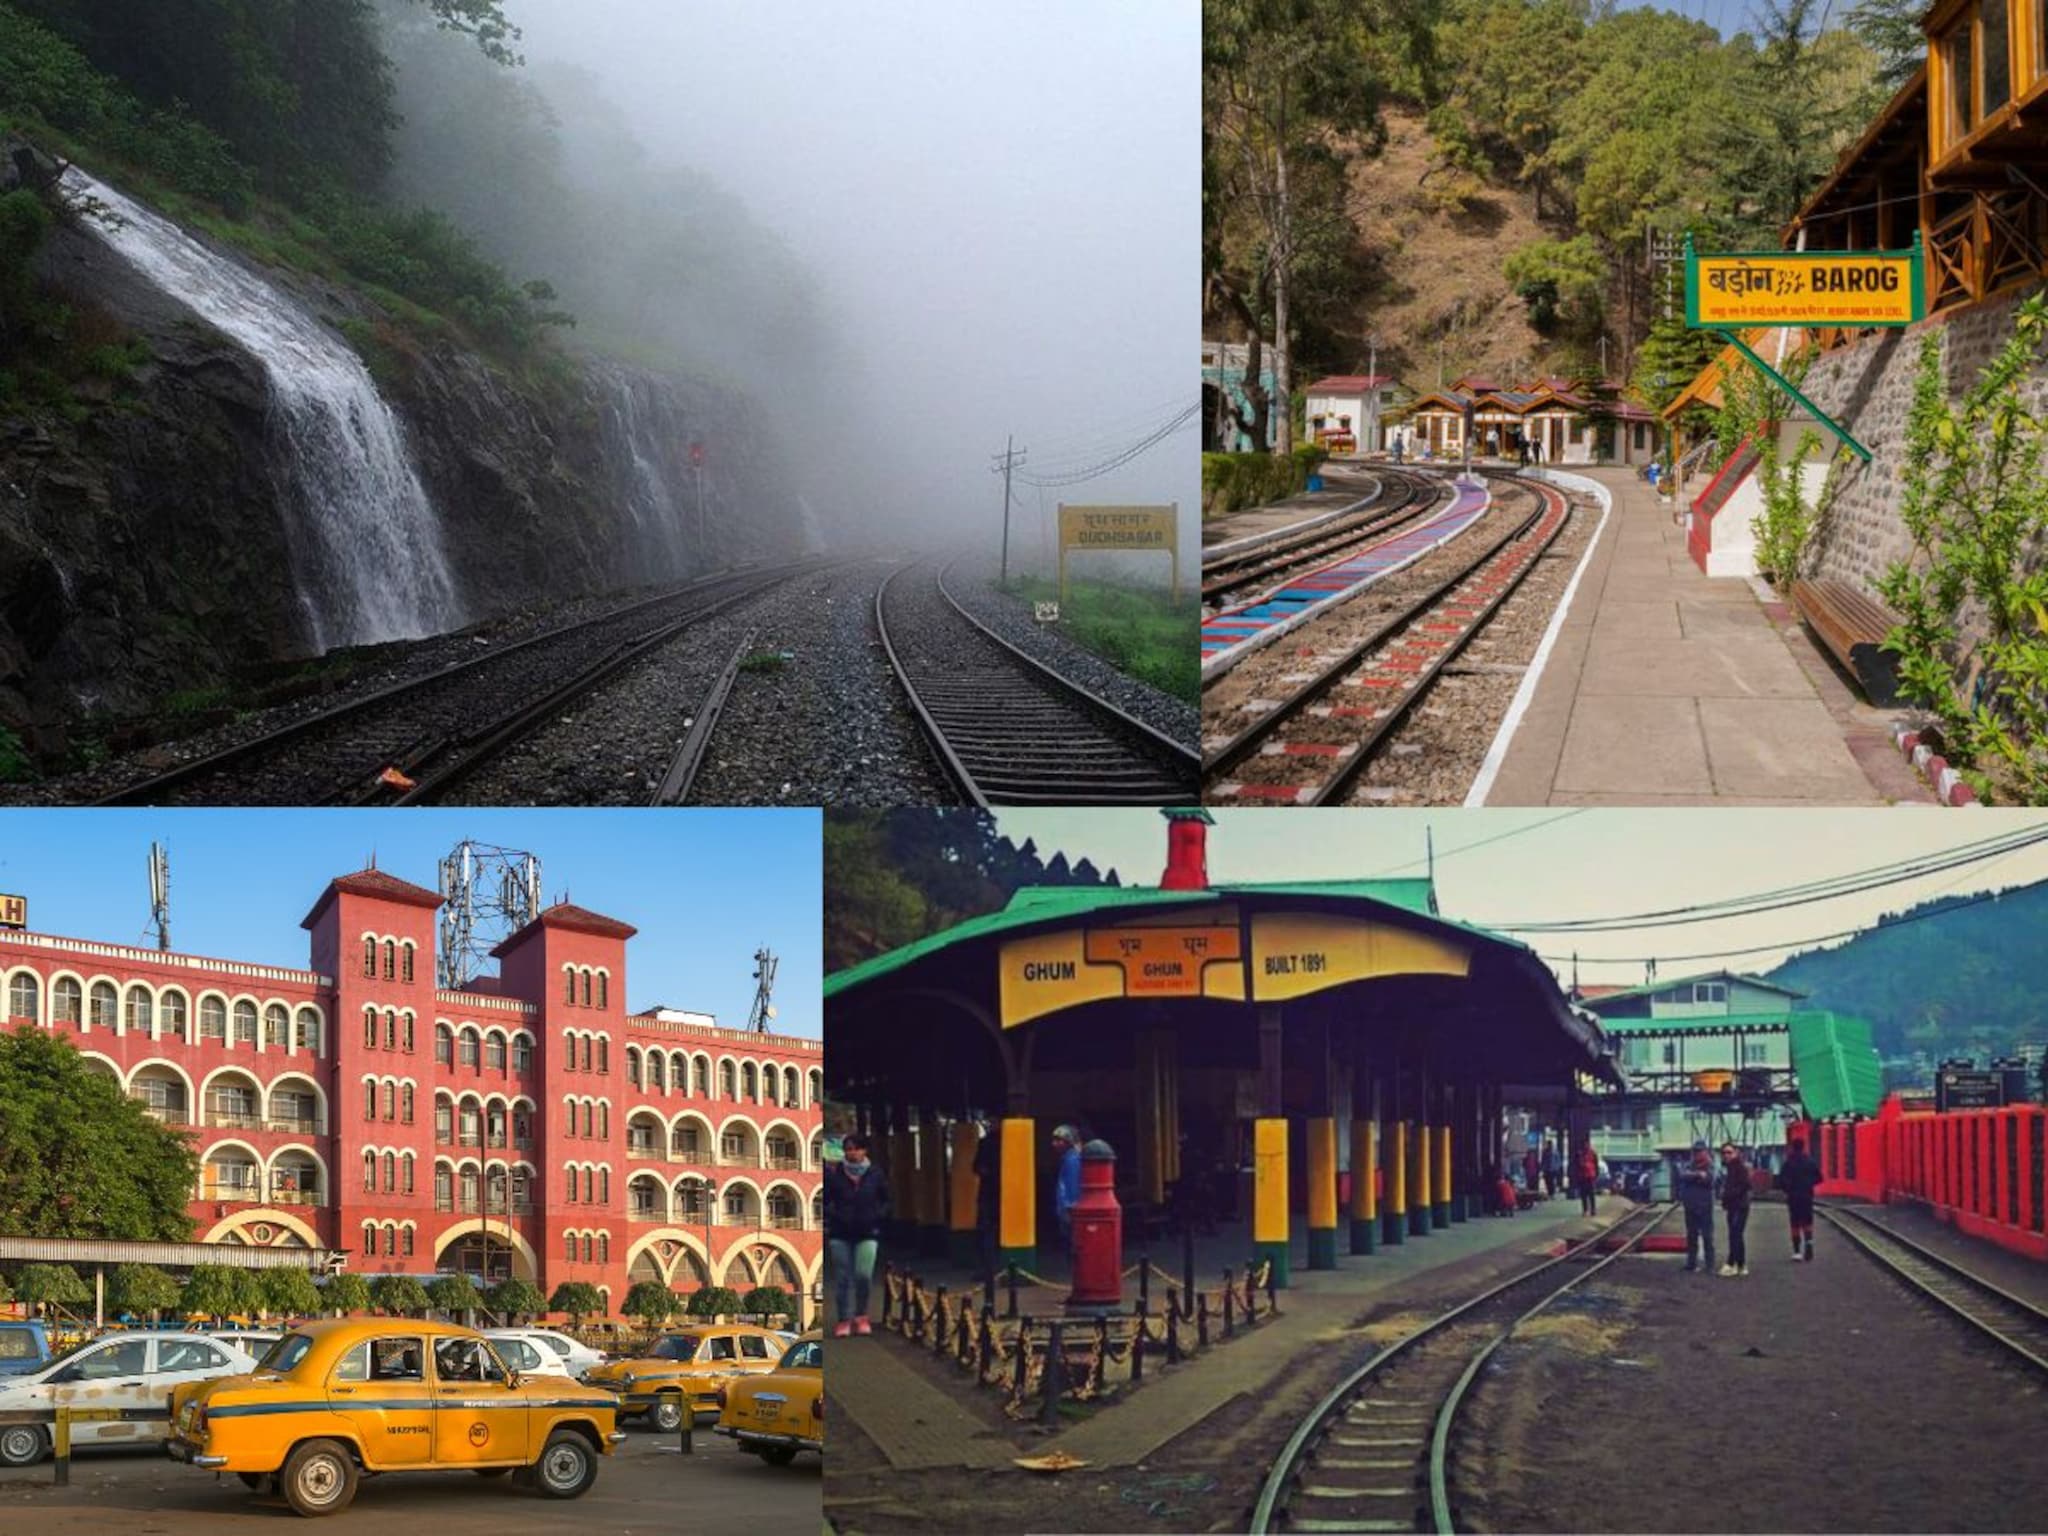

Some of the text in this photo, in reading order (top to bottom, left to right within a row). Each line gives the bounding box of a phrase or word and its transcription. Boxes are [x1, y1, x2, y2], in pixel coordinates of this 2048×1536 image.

[1812, 266, 1899, 292] BAROG
[1024, 961, 1076, 982] GHUM
[1143, 962, 1183, 977] GHUM
[1265, 952, 1326, 975] BUILT 1891
